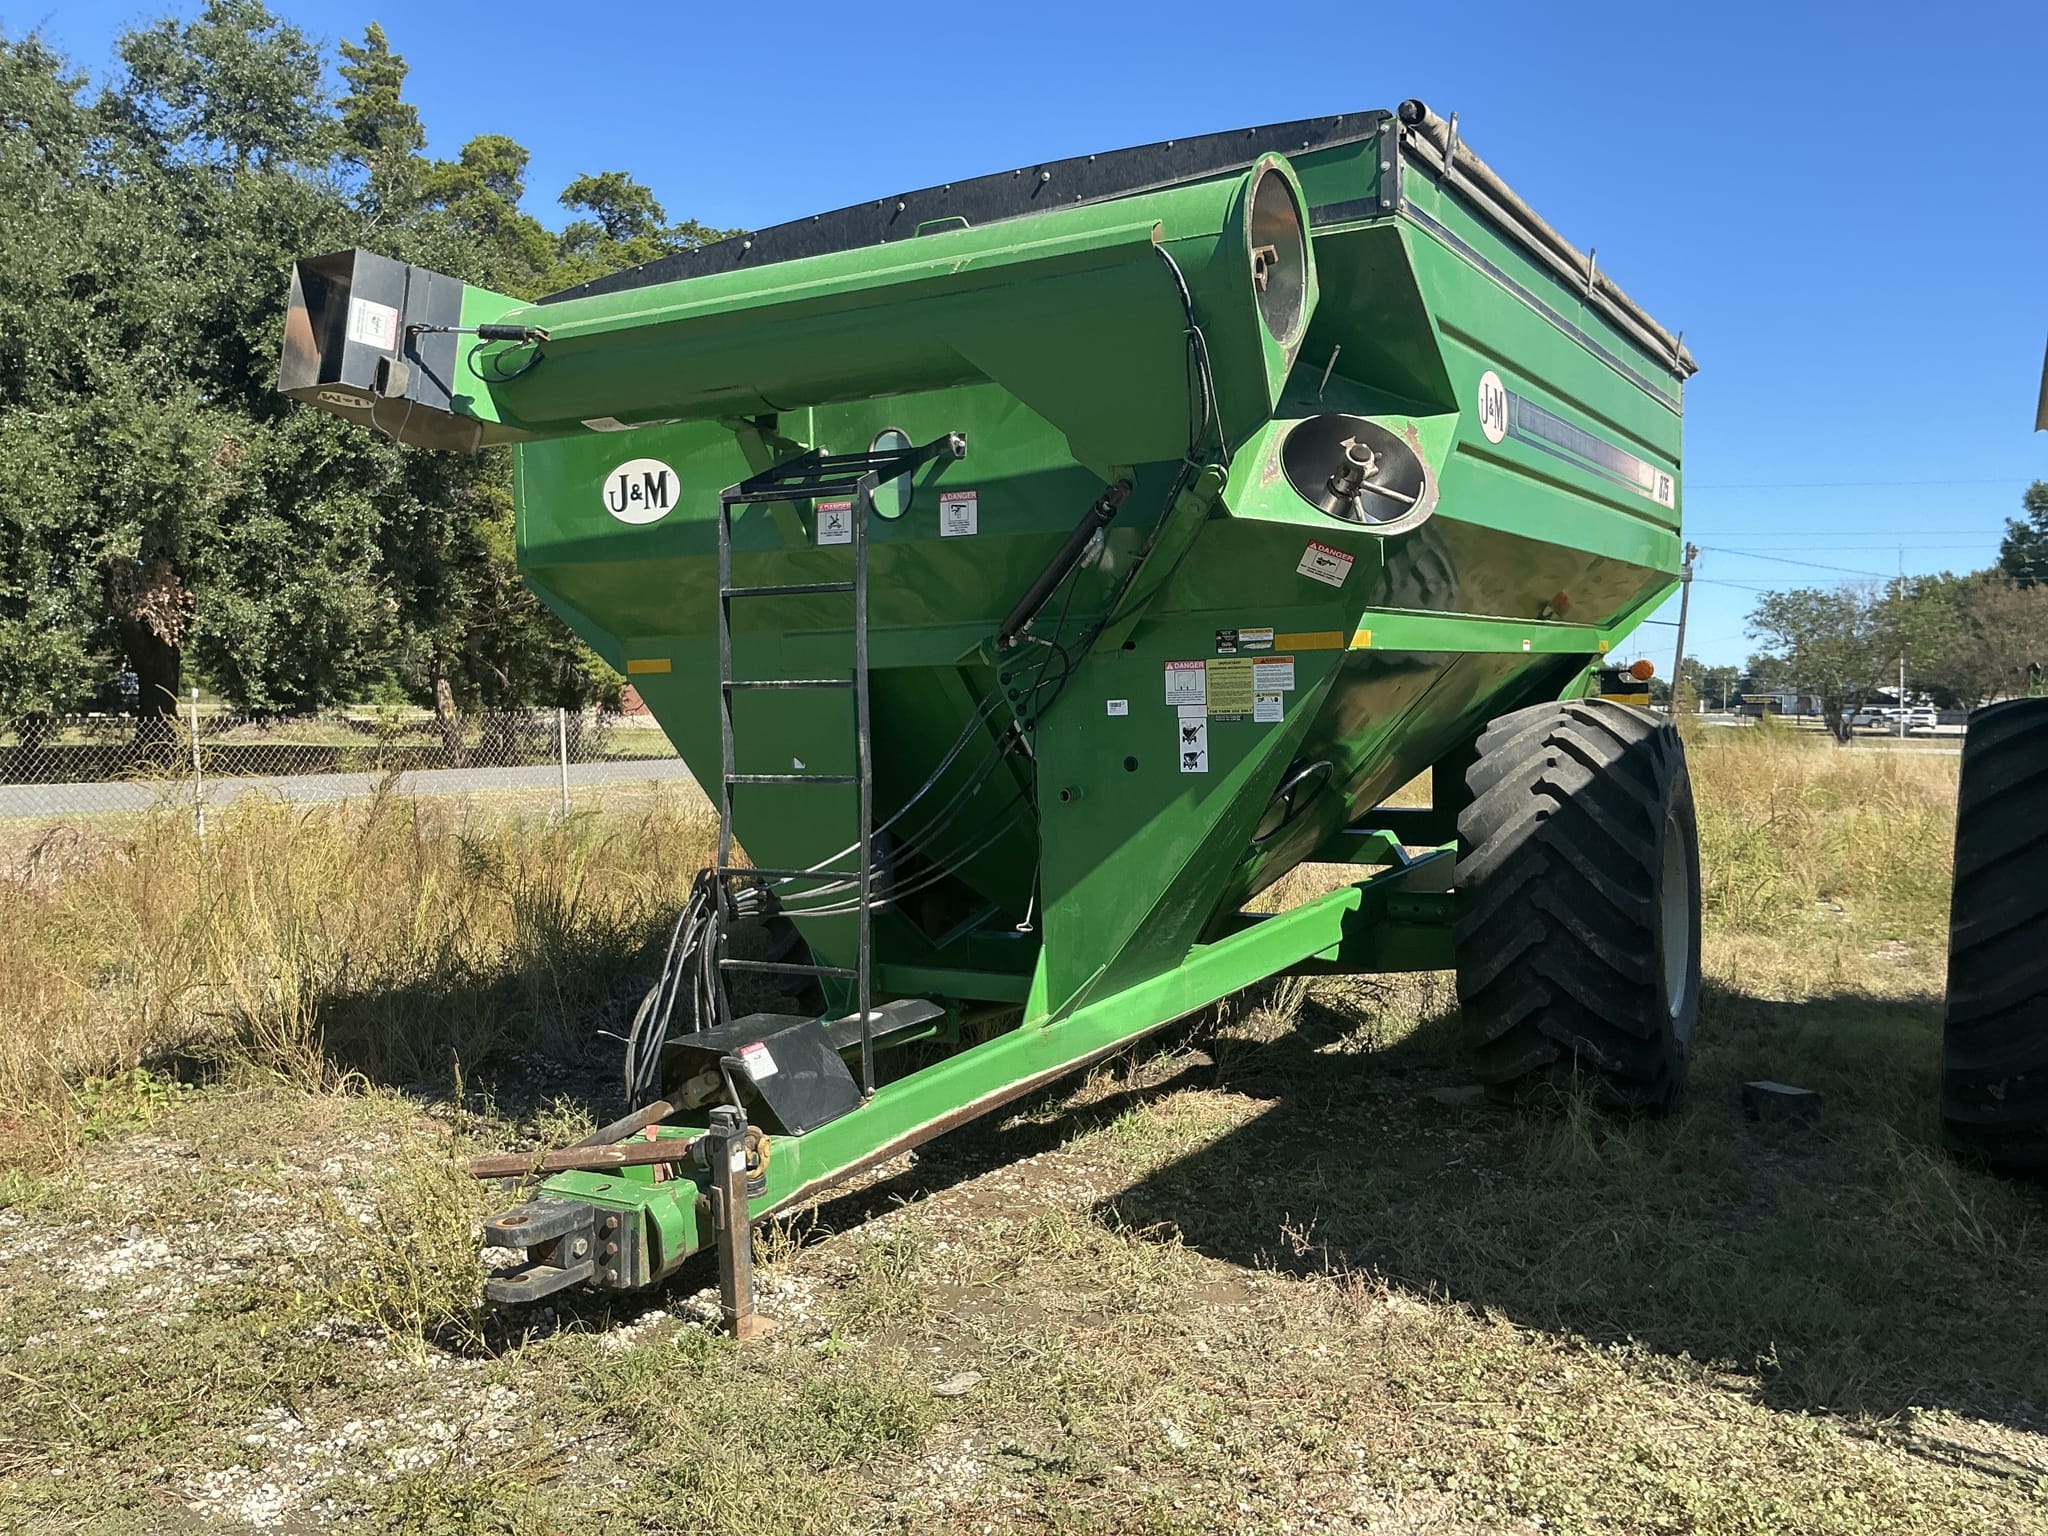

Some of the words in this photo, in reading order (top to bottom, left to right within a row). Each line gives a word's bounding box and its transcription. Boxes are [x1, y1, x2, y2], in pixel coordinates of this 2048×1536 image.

[1480, 383, 1503, 432] J&M
[608, 470, 669, 513] J&M
[948, 491, 977, 501] DANGER
[823, 501, 851, 511] DANGER
[1318, 544, 1354, 562] DANGER
[1174, 661, 1205, 670] DANGER
